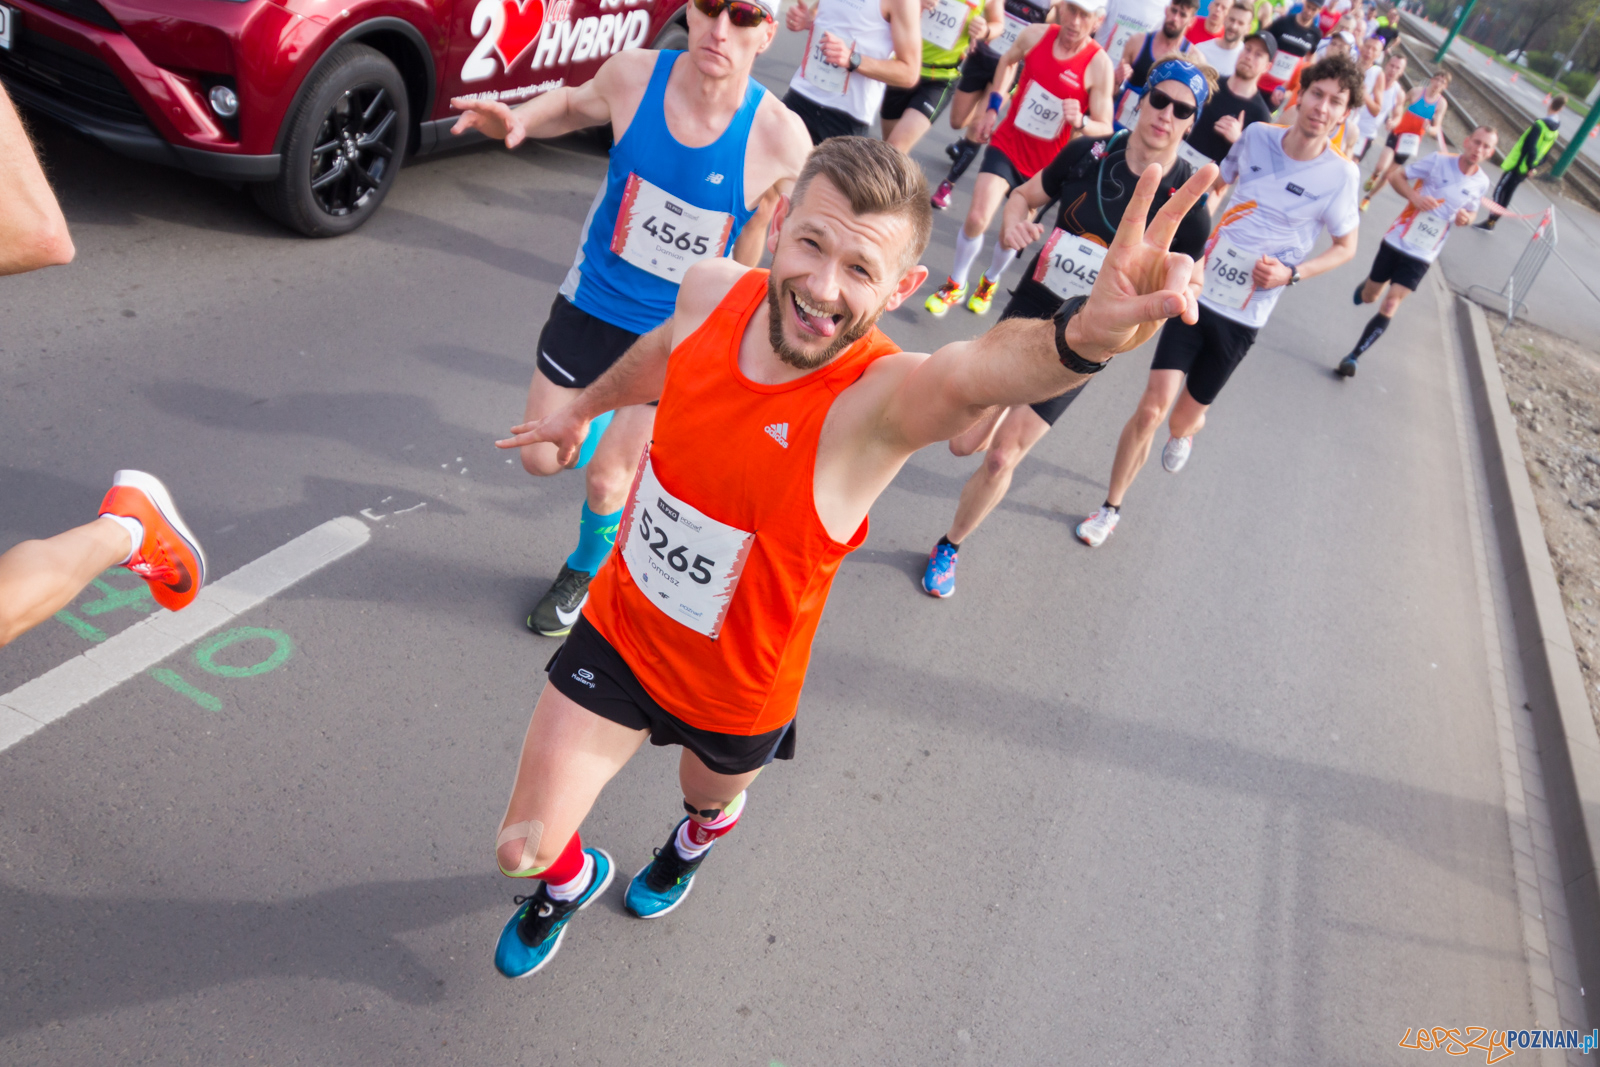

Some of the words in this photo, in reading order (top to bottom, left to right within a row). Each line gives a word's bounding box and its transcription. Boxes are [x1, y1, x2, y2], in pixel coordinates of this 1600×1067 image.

[531, 10, 650, 69] HYBRYD
[1028, 98, 1059, 121] 7087
[642, 215, 709, 255] 4565
[1418, 222, 1439, 237] 1942
[656, 245, 684, 261] Damian
[1055, 253, 1098, 285] 1045
[1212, 257, 1249, 285] 7685
[764, 425, 789, 449] adidas
[639, 507, 716, 585] 5265
[648, 555, 680, 587] Tomasz
